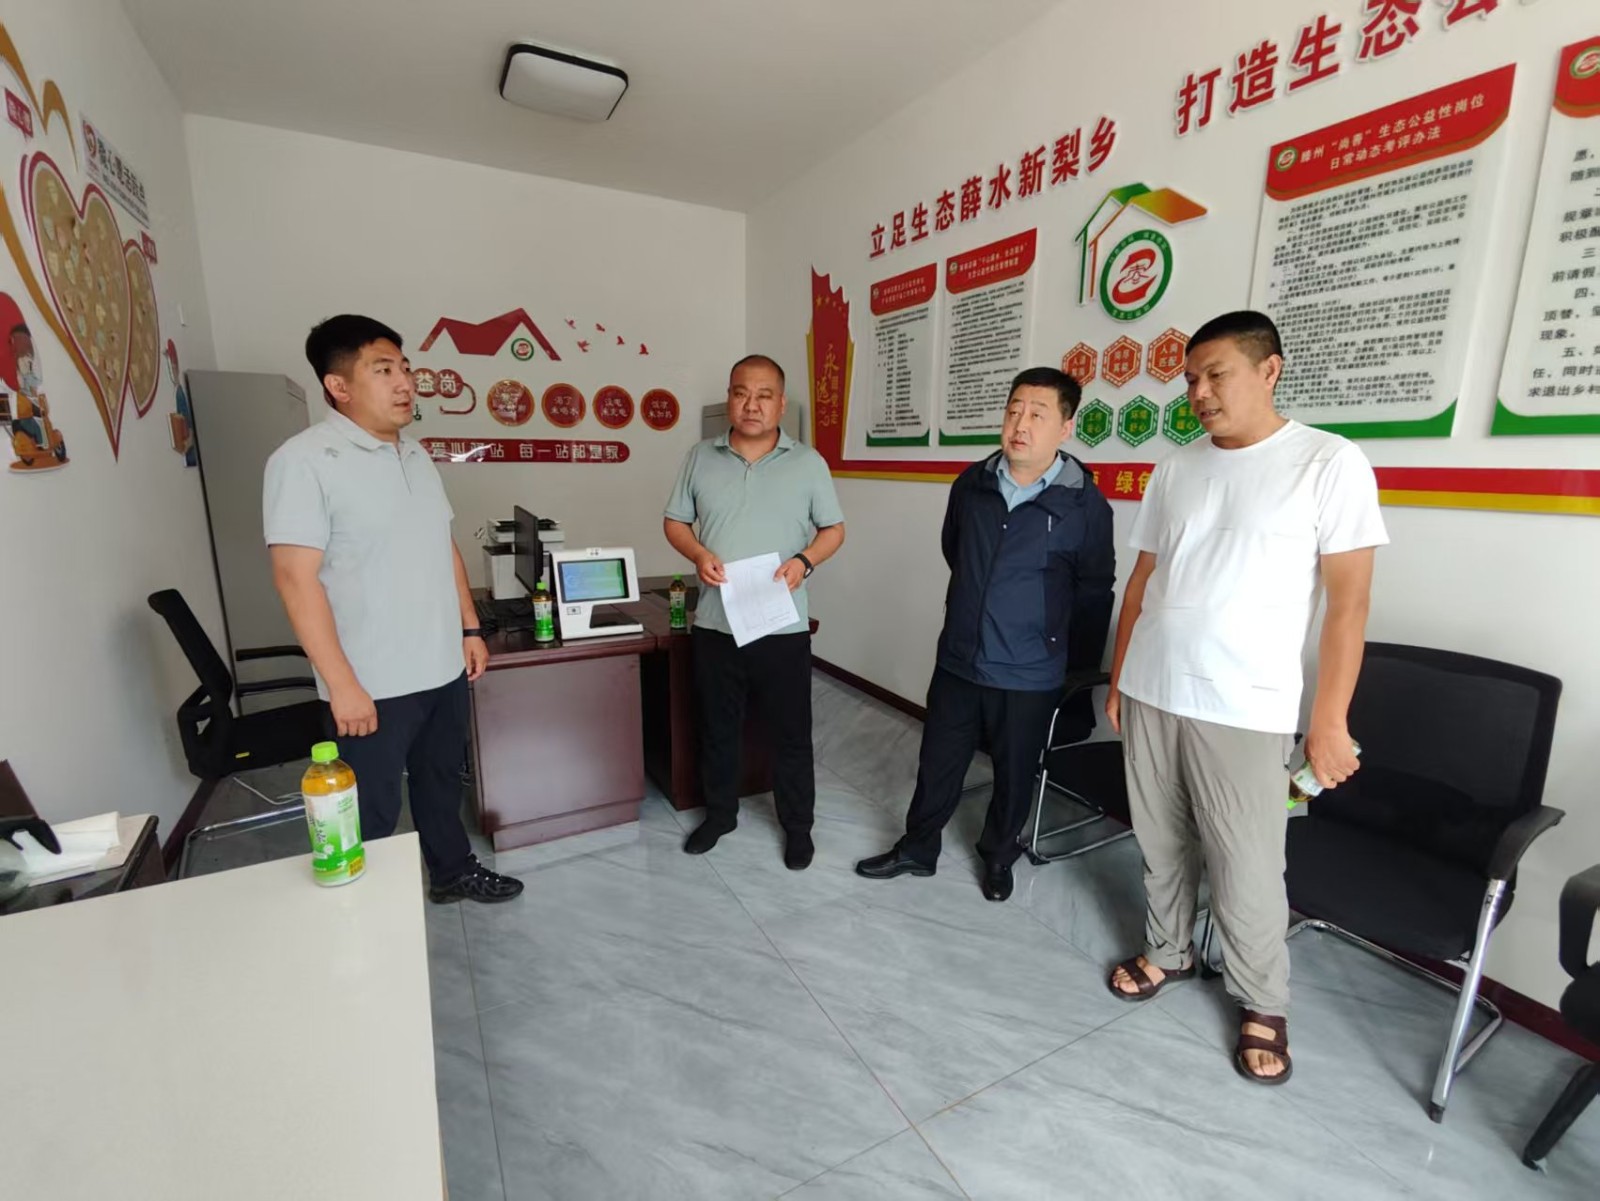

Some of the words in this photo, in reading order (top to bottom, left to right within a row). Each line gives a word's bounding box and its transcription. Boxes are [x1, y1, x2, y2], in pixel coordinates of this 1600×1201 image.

[869, 116, 1116, 258] 立足生态薛水新梨乡
[519, 443, 619, 460] 每一站都是家
